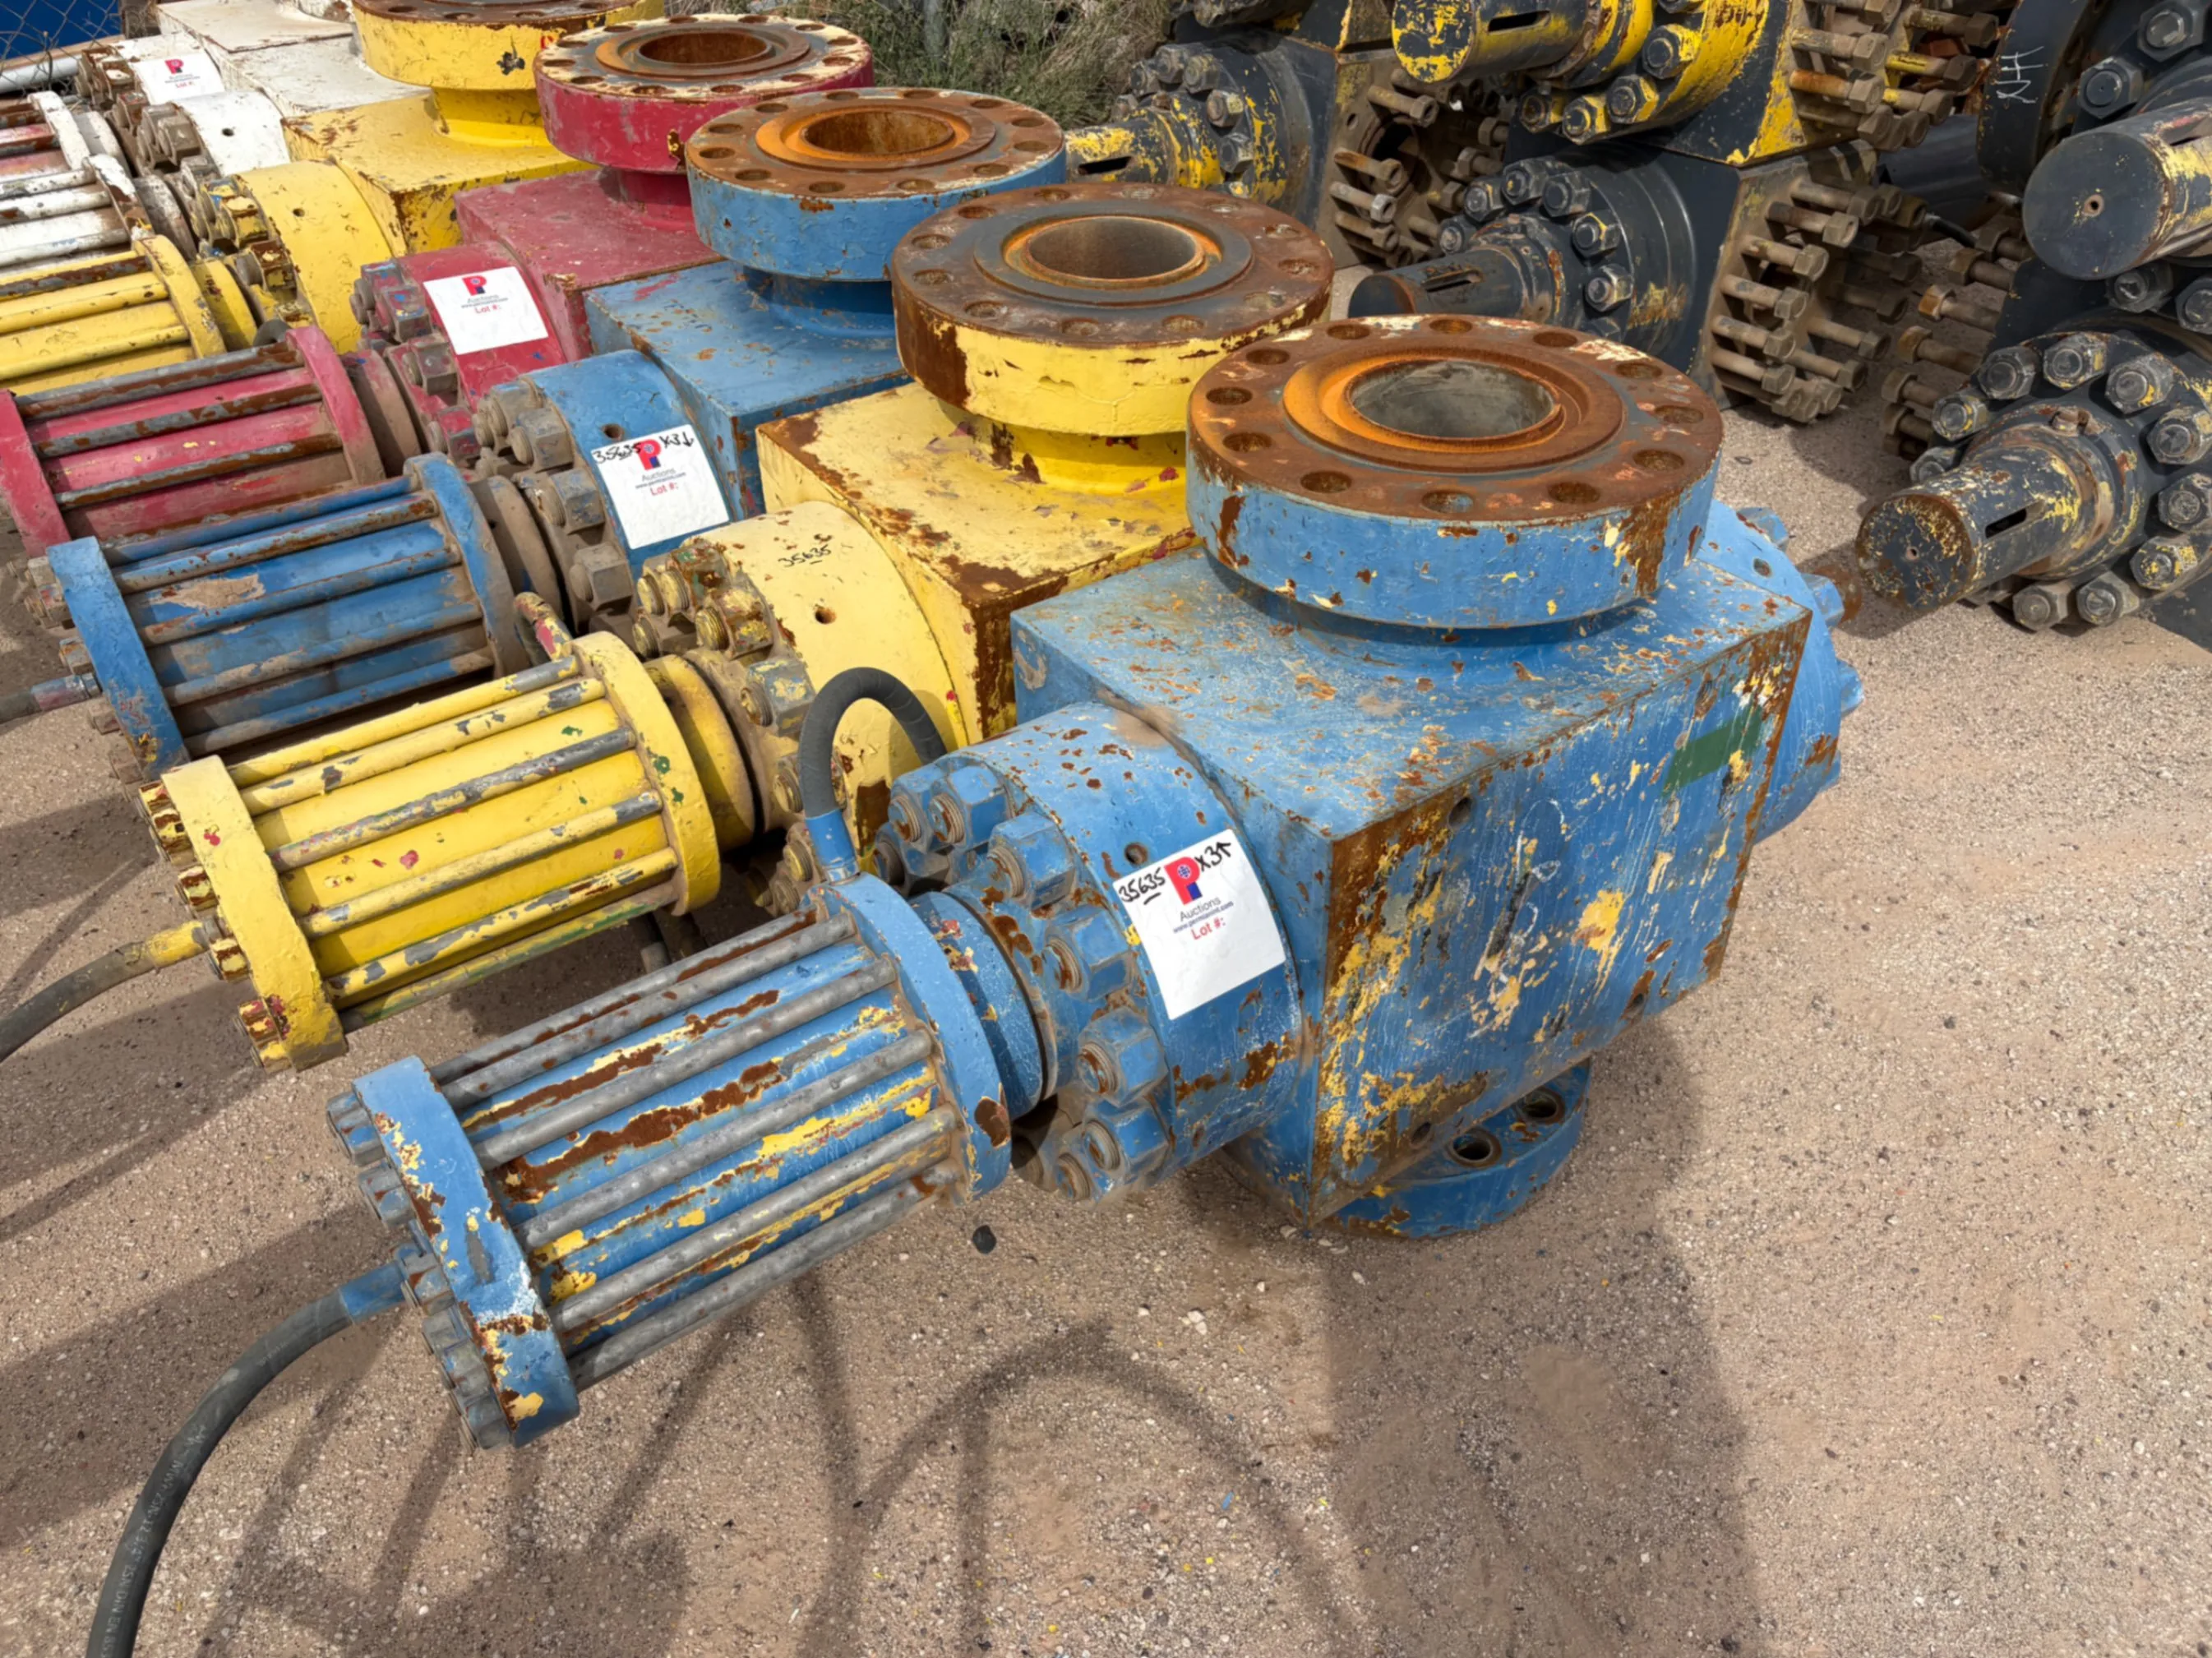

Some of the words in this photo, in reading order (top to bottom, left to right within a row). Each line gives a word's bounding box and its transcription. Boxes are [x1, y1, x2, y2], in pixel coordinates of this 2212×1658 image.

[473, 304, 491, 314] Lot
[641, 467, 677, 482] Auctions
[650, 484, 667, 496] Lot
[778, 544, 832, 567] 35635
[1119, 868, 1166, 903] 35635
[1180, 896, 1221, 922] Auctions
[1190, 921, 1213, 940] Lot
[1213, 917, 1226, 931] #:
